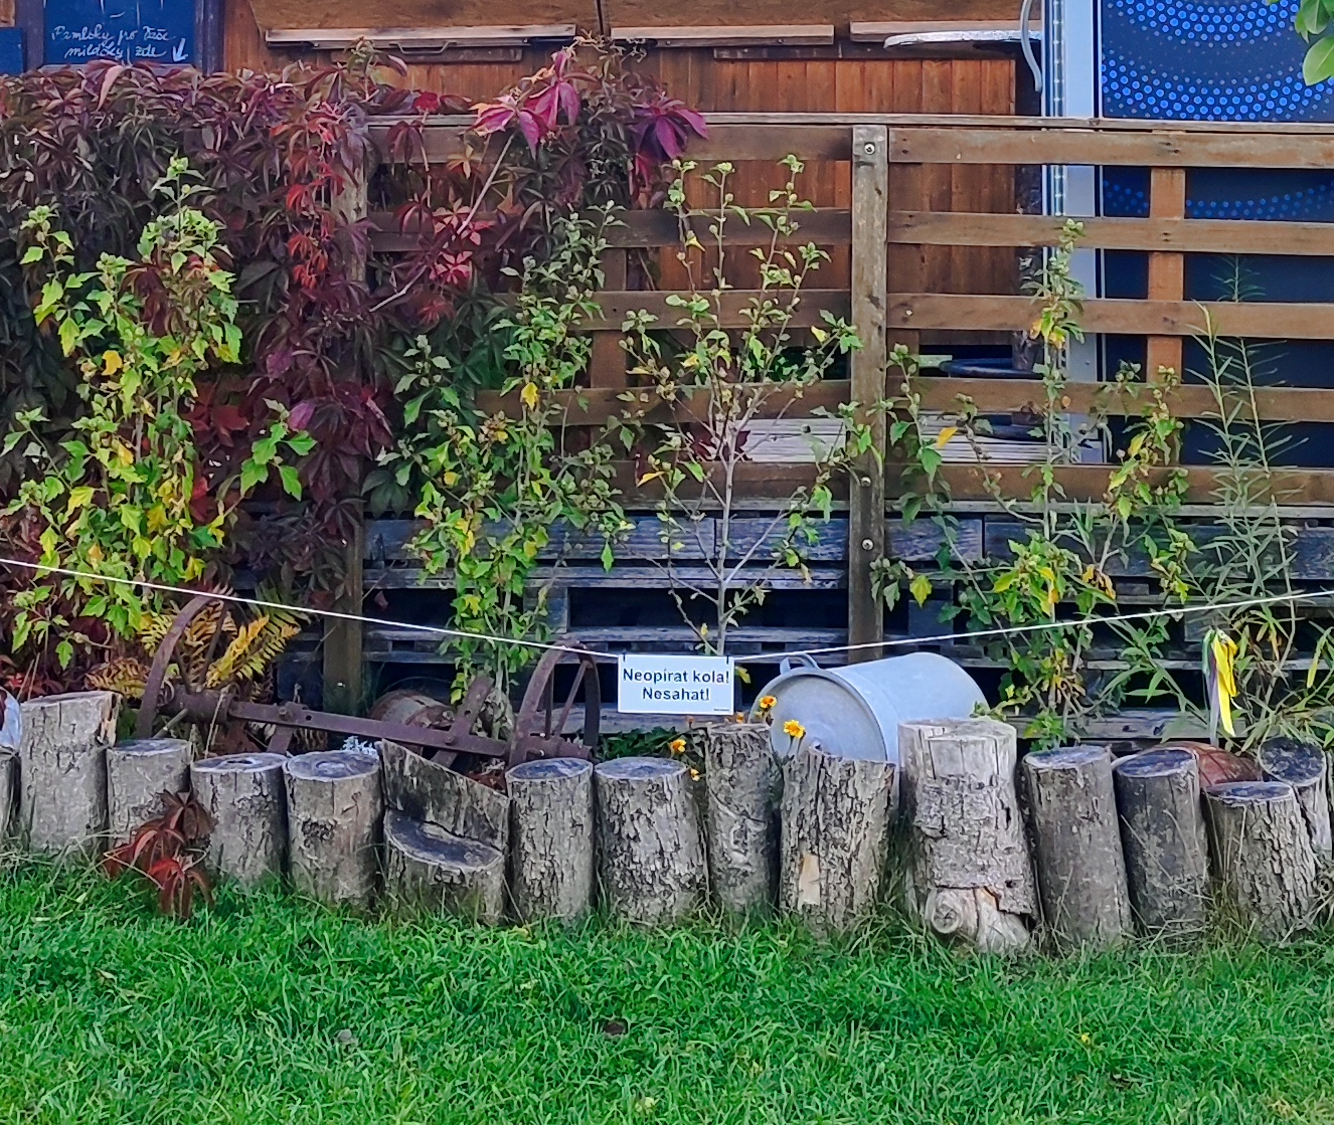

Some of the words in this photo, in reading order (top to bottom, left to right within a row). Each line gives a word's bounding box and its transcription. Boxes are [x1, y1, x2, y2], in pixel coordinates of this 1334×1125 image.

[623, 668, 688, 685] Neopírat
[693, 670, 730, 684] kola!
[642, 687, 710, 701] Nesahat!
